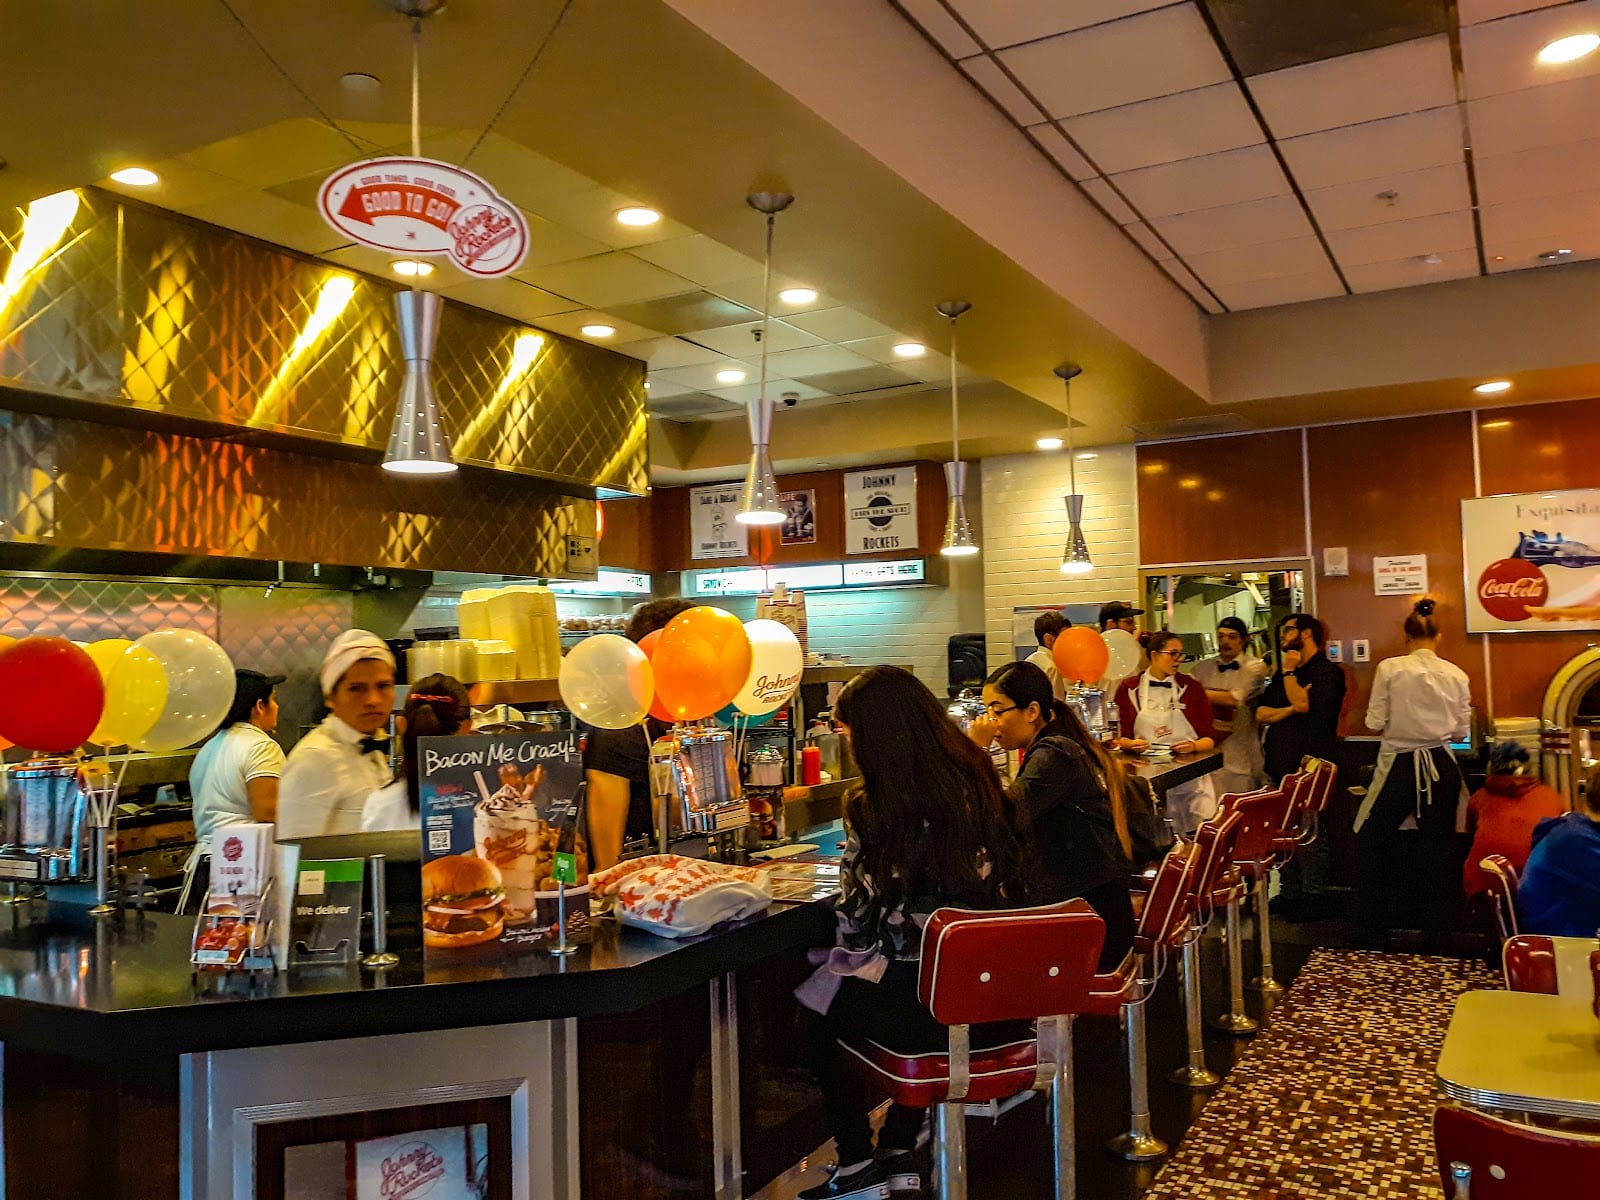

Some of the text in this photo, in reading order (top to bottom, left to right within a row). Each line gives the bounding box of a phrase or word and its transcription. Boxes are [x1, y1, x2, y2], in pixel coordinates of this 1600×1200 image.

[361, 191, 453, 223] GOOD TO GO!
[863, 474, 897, 489] JOHNNY
[863, 535, 899, 550] ROCKETS
[487, 743, 514, 766] Me
[518, 733, 576, 763] Crazy!
[296, 904, 351, 916] We deliver
